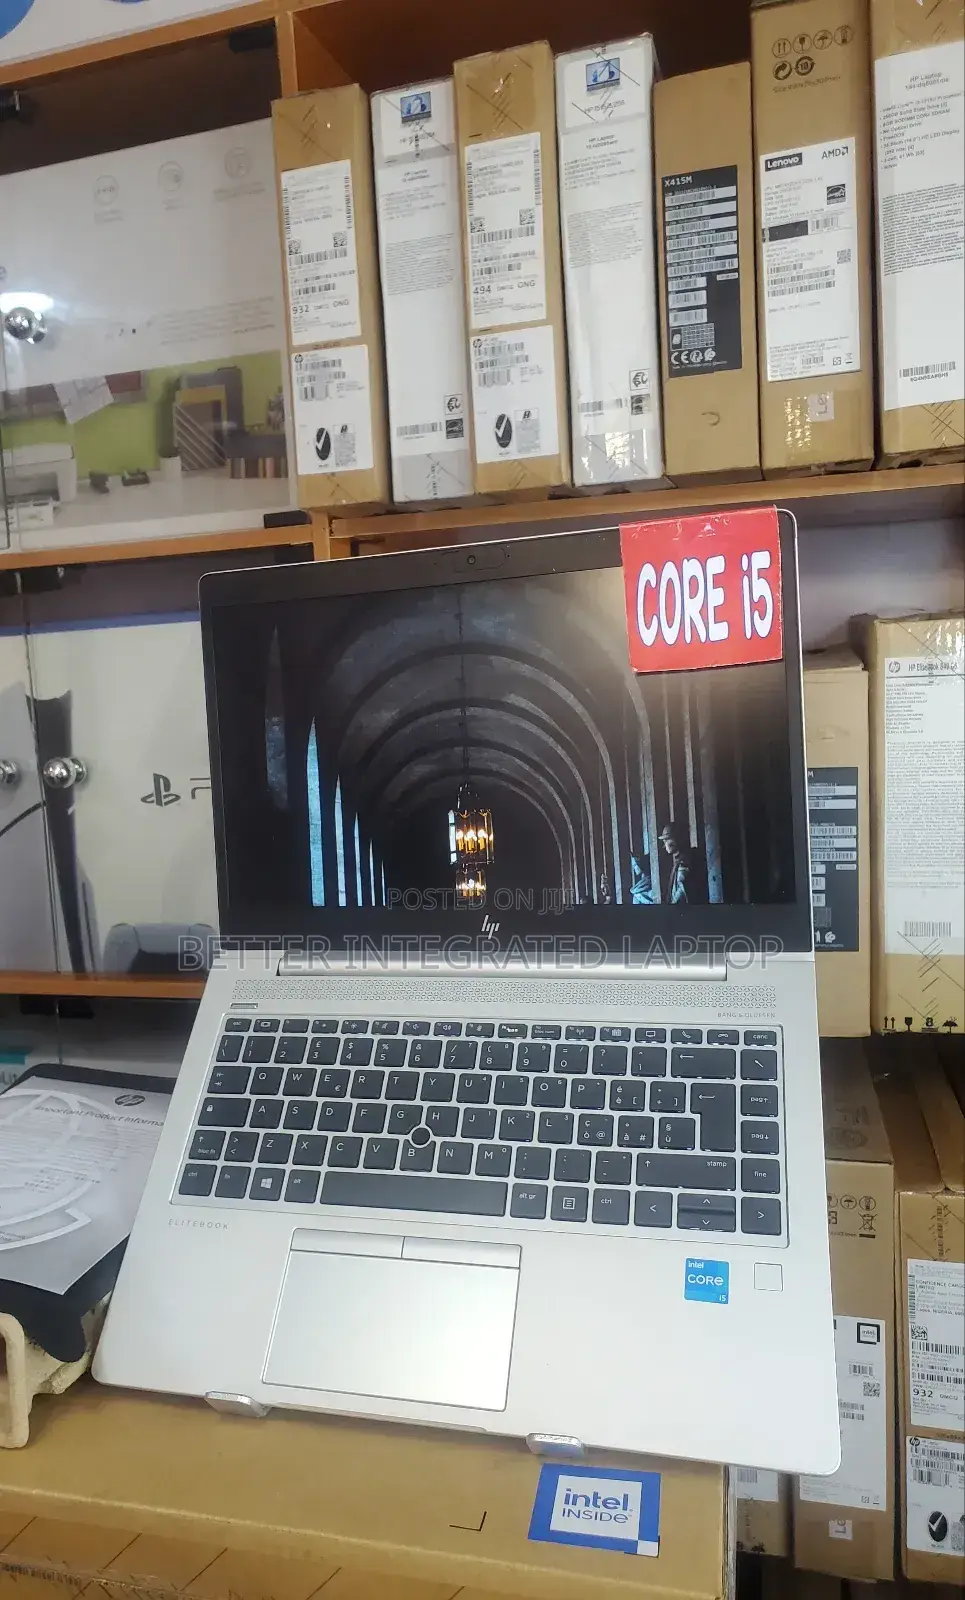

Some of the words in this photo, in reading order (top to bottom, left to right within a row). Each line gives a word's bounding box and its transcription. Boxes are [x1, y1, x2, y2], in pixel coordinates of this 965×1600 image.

[921, 72, 942, 81] Laptop
[822, 149, 841, 159] AMD
[767, 156, 799, 169] Lenovo
[664, 176, 693, 187] X415M
[518, 280, 535, 288] ONG
[473, 285, 491, 294] 494
[293, 305, 309, 315] 932
[637, 554, 729, 647] CORE
[741, 550, 774, 640] i5
[292, 1073, 303, 1081] W
[429, 1078, 436, 1086] Y
[465, 1080, 473, 1088] U
[540, 1083, 549, 1091] O
[577, 1085, 585, 1093] P
[616, 1085, 623, 1093] é
[35, 1105, 84, 1117] Important
[84, 1111, 124, 1121] Product
[326, 1108, 334, 1116] D
[360, 1109, 368, 1117] F
[396, 1111, 405, 1119] G
[432, 1112, 440, 1120] H
[469, 1114, 475, 1122] J
[507, 1116, 515, 1125] K
[546, 1119, 552, 1127] L
[596, 1131, 605, 1139] @
[266, 1140, 273, 1148] Z
[336, 1143, 344, 1151] C
[372, 1145, 380, 1153] V
[408, 1149, 416, 1157] B
[445, 1149, 454, 1157] N
[484, 1151, 493, 1160] M
[754, 1170, 767, 1178] fine
[168, 1218, 229, 1230] ELITEBOOK
[688, 1261, 705, 1269] intel
[913, 1388, 934, 1399] 932
[564, 1487, 630, 1511] intel
